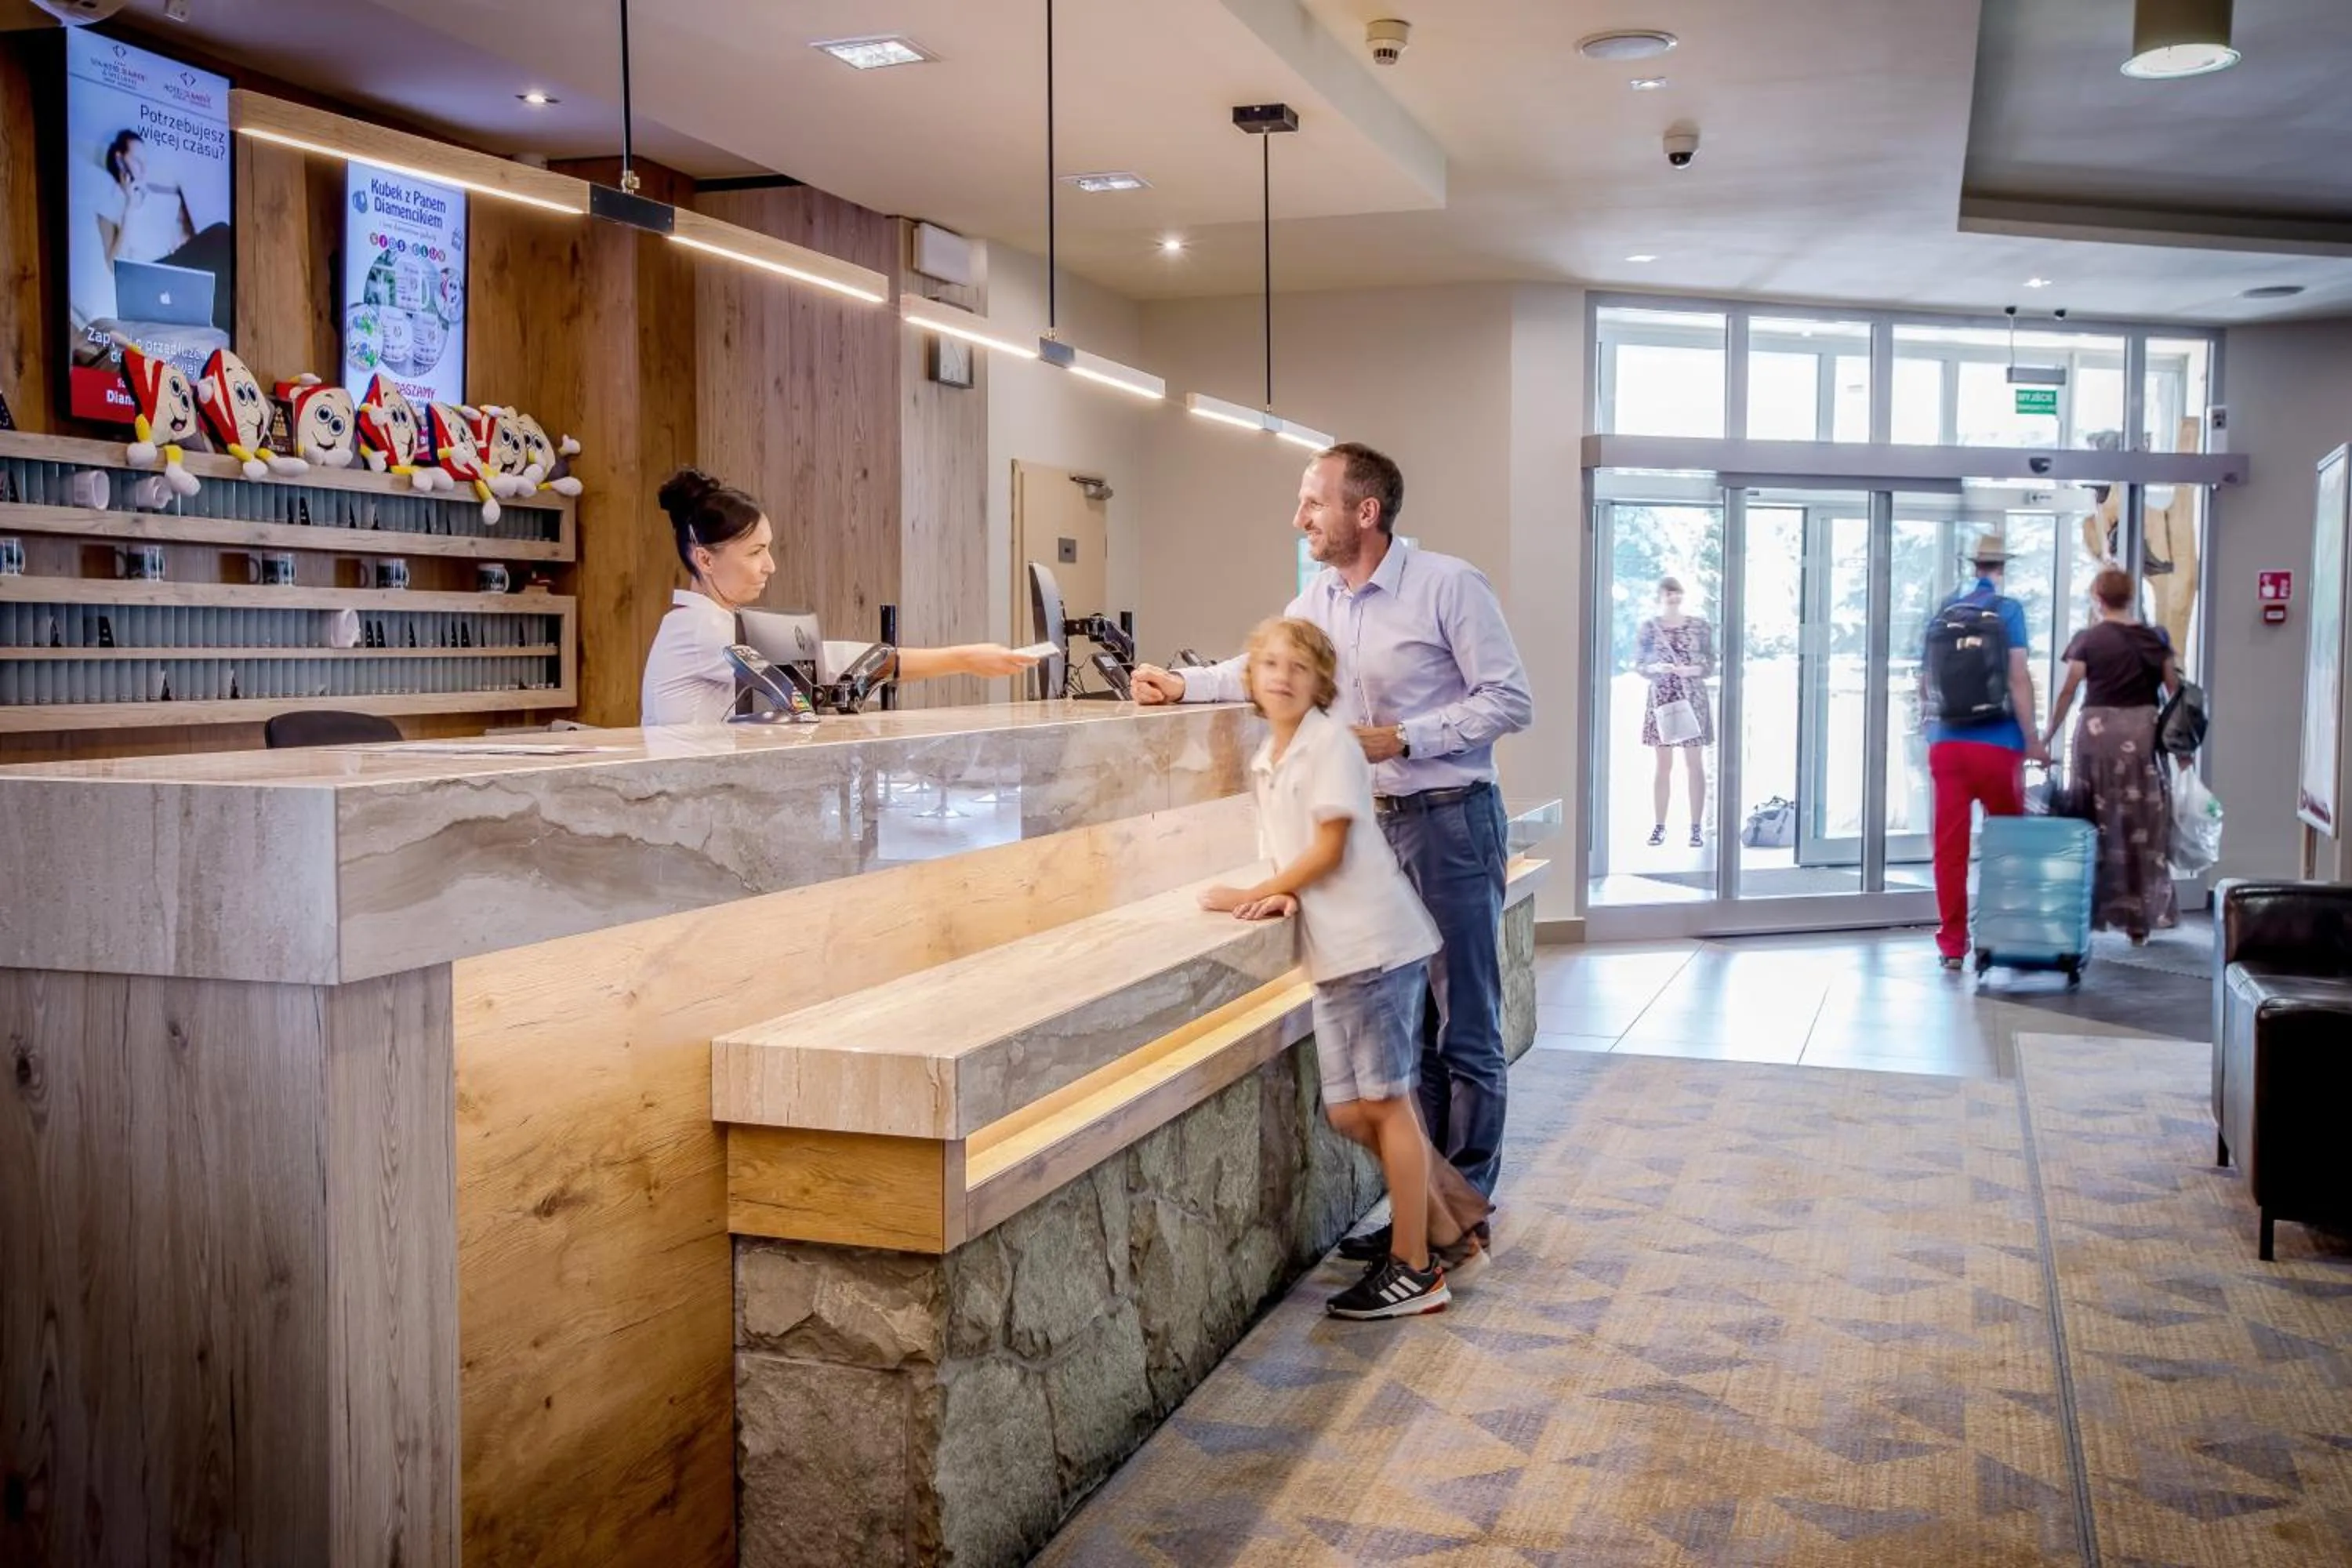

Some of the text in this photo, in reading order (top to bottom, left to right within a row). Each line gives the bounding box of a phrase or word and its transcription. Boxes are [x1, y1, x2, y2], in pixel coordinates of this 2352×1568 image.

[140, 103, 225, 144] Potrzebujesz
[137, 124, 226, 161] więcej czasu?
[371, 178, 446, 214] Kubek z Panem
[374, 196, 443, 229] Diamencikiem
